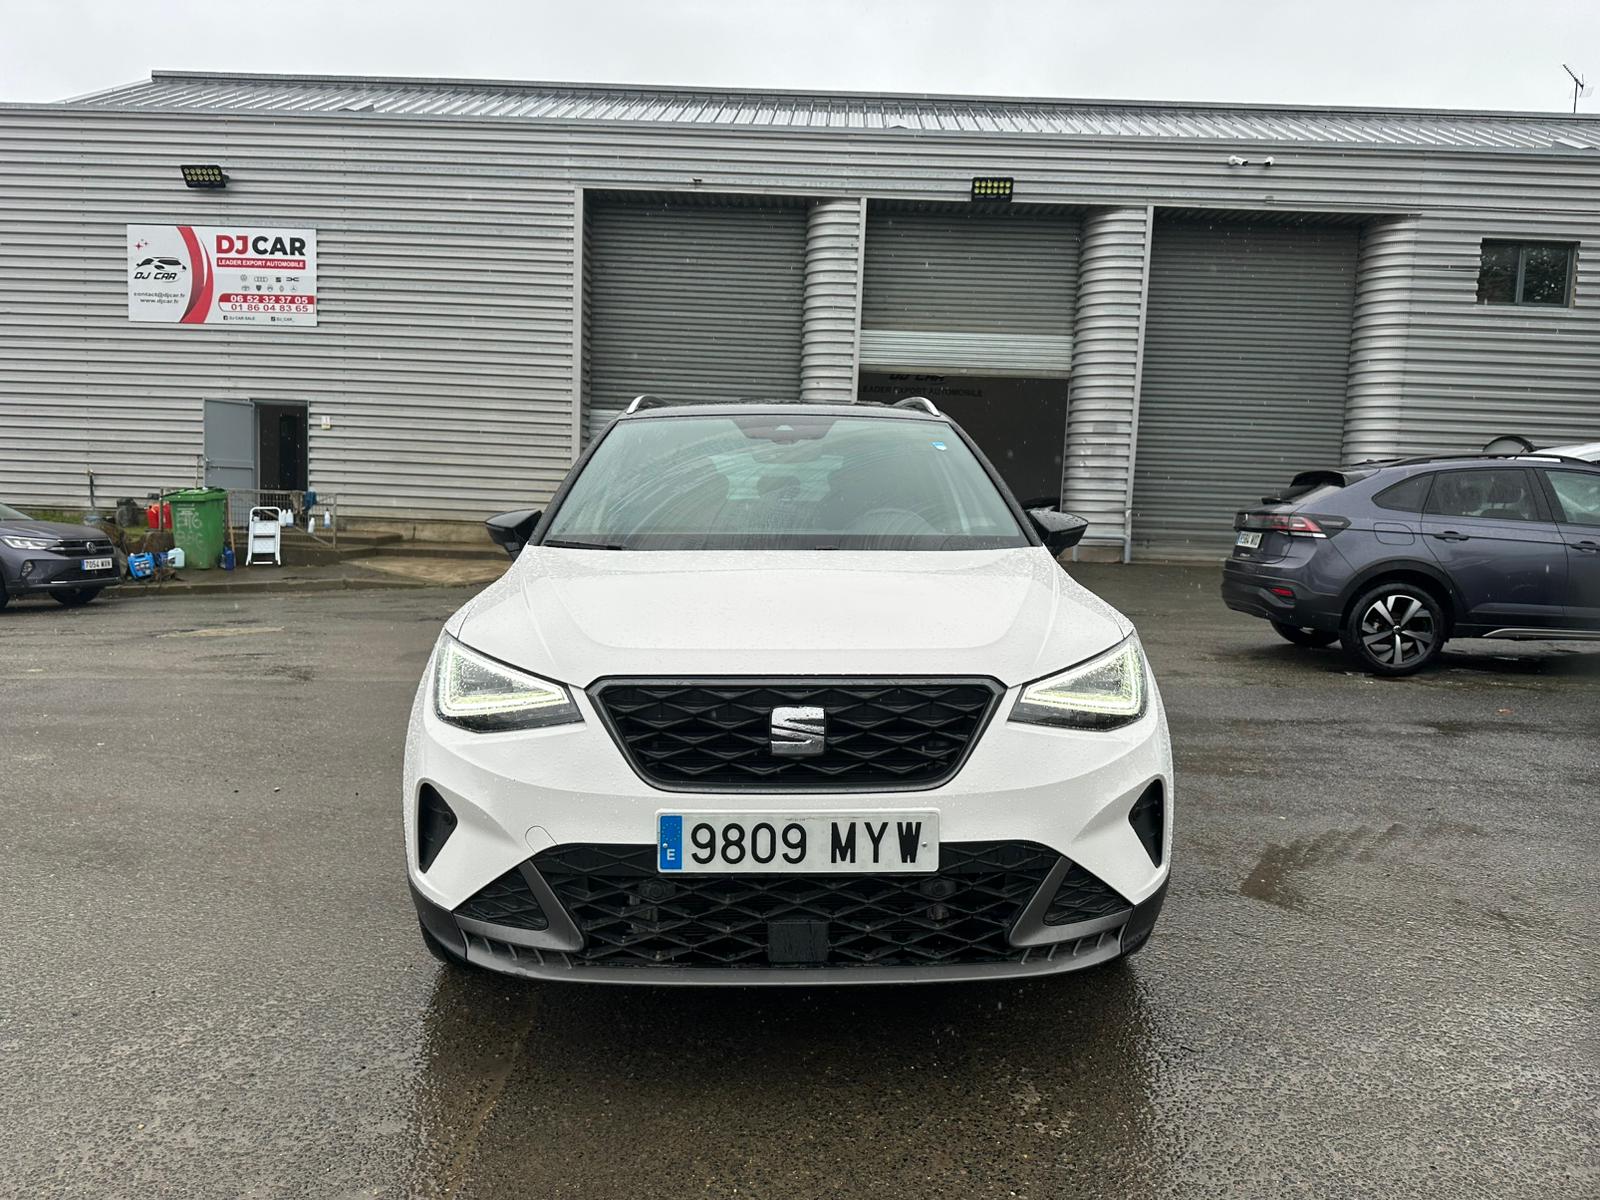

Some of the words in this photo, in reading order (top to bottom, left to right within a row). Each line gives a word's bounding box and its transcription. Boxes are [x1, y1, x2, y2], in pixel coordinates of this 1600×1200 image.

[216, 235, 249, 255] DJ
[252, 235, 306, 256] CAR
[266, 260, 304, 268] AUTOMOBILE
[153, 272, 177, 280] CAR
[230, 295, 244, 303] 06
[246, 295, 260, 304] 52
[262, 295, 276, 304] 32
[279, 296, 292, 304] 37
[294, 296, 309, 304] 05
[230, 303, 243, 311] 01
[247, 303, 260, 311] 86
[263, 304, 276, 312] 04
[279, 304, 293, 312] 83
[295, 304, 309, 313] 65
[666, 849, 675, 860] E
[691, 822, 807, 865] 9809
[830, 821, 922, 864] MYW
